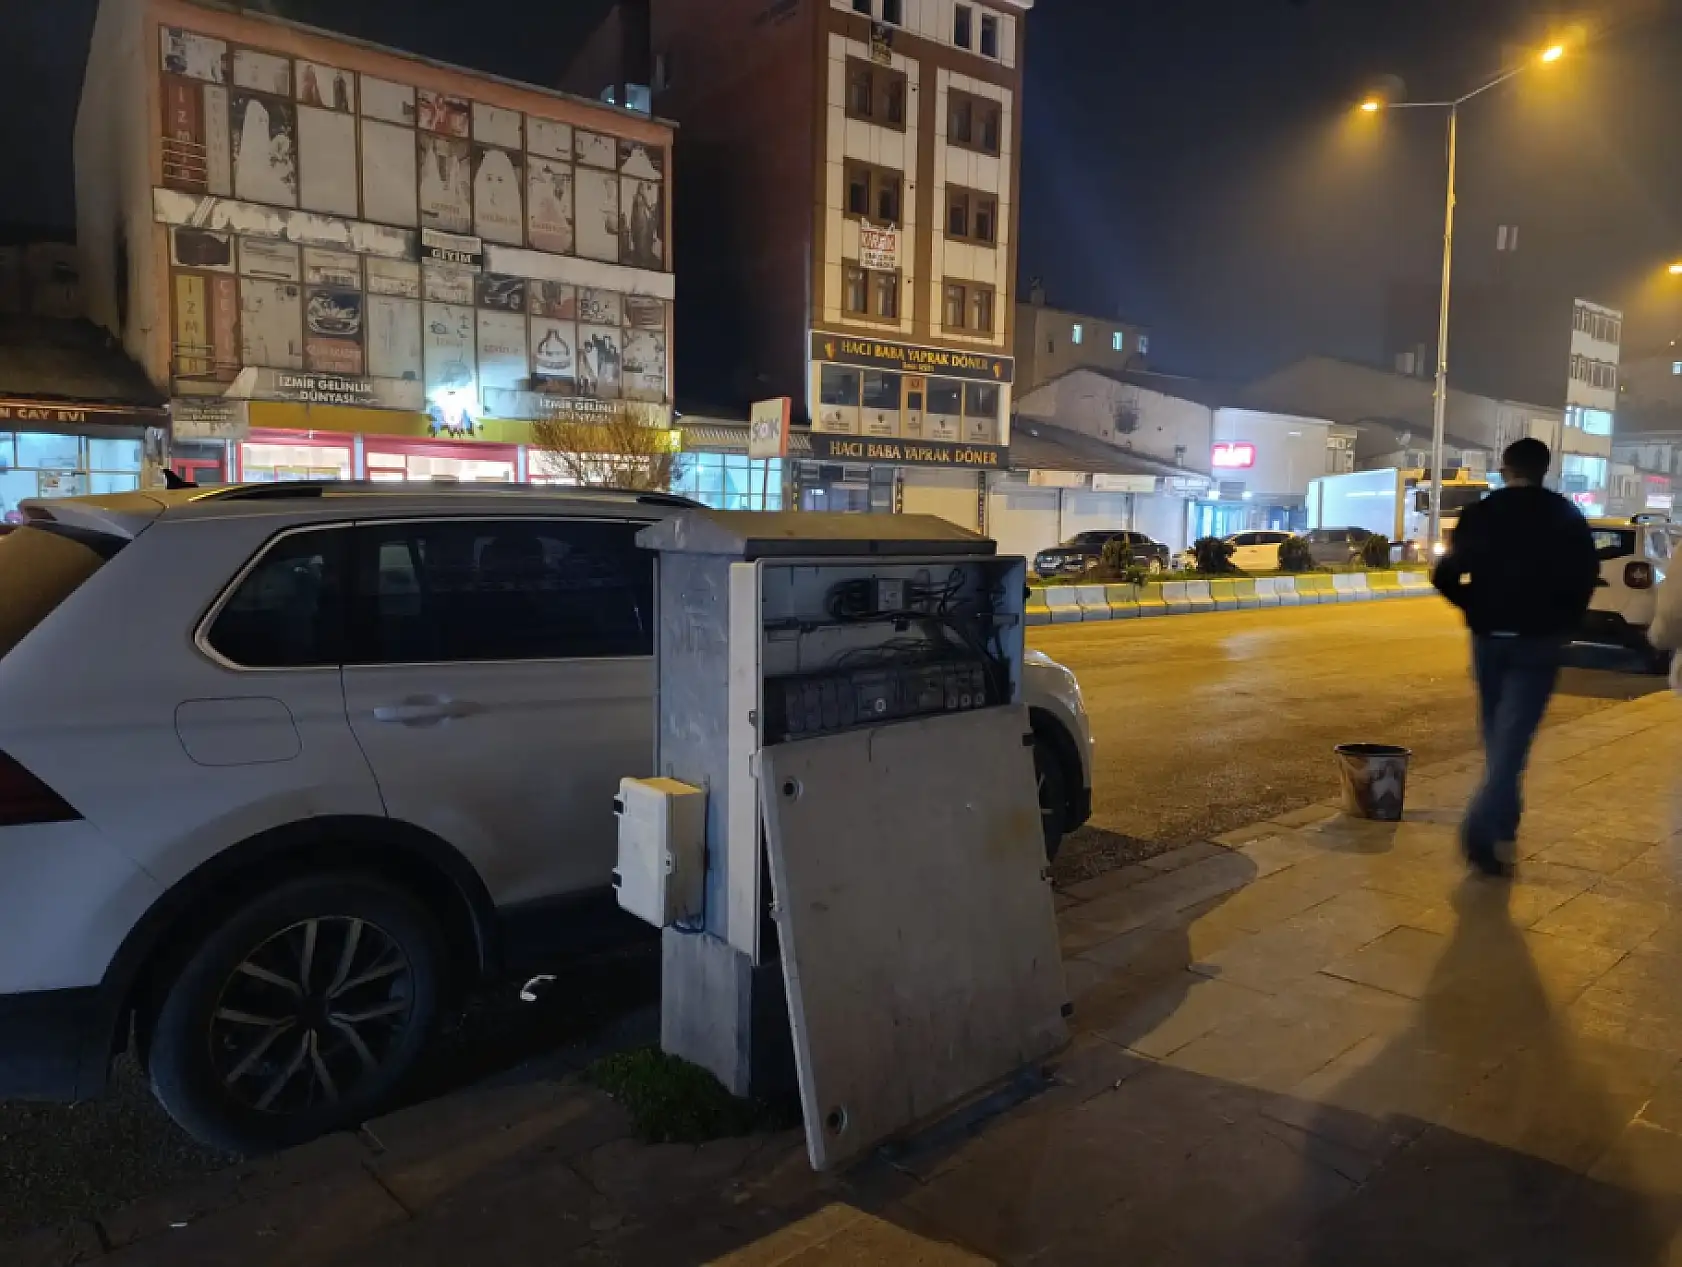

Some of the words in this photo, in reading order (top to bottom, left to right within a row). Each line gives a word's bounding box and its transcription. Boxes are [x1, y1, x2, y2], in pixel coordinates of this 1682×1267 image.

[841, 338, 872, 357] HACI
[874, 343, 905, 361] BABA
[951, 352, 989, 371] DÖNER
[829, 440, 863, 457] HACI
[867, 443, 901, 460] BABA
[904, 446, 951, 463] YAPRAK
[955, 446, 998, 465] DÖNER
